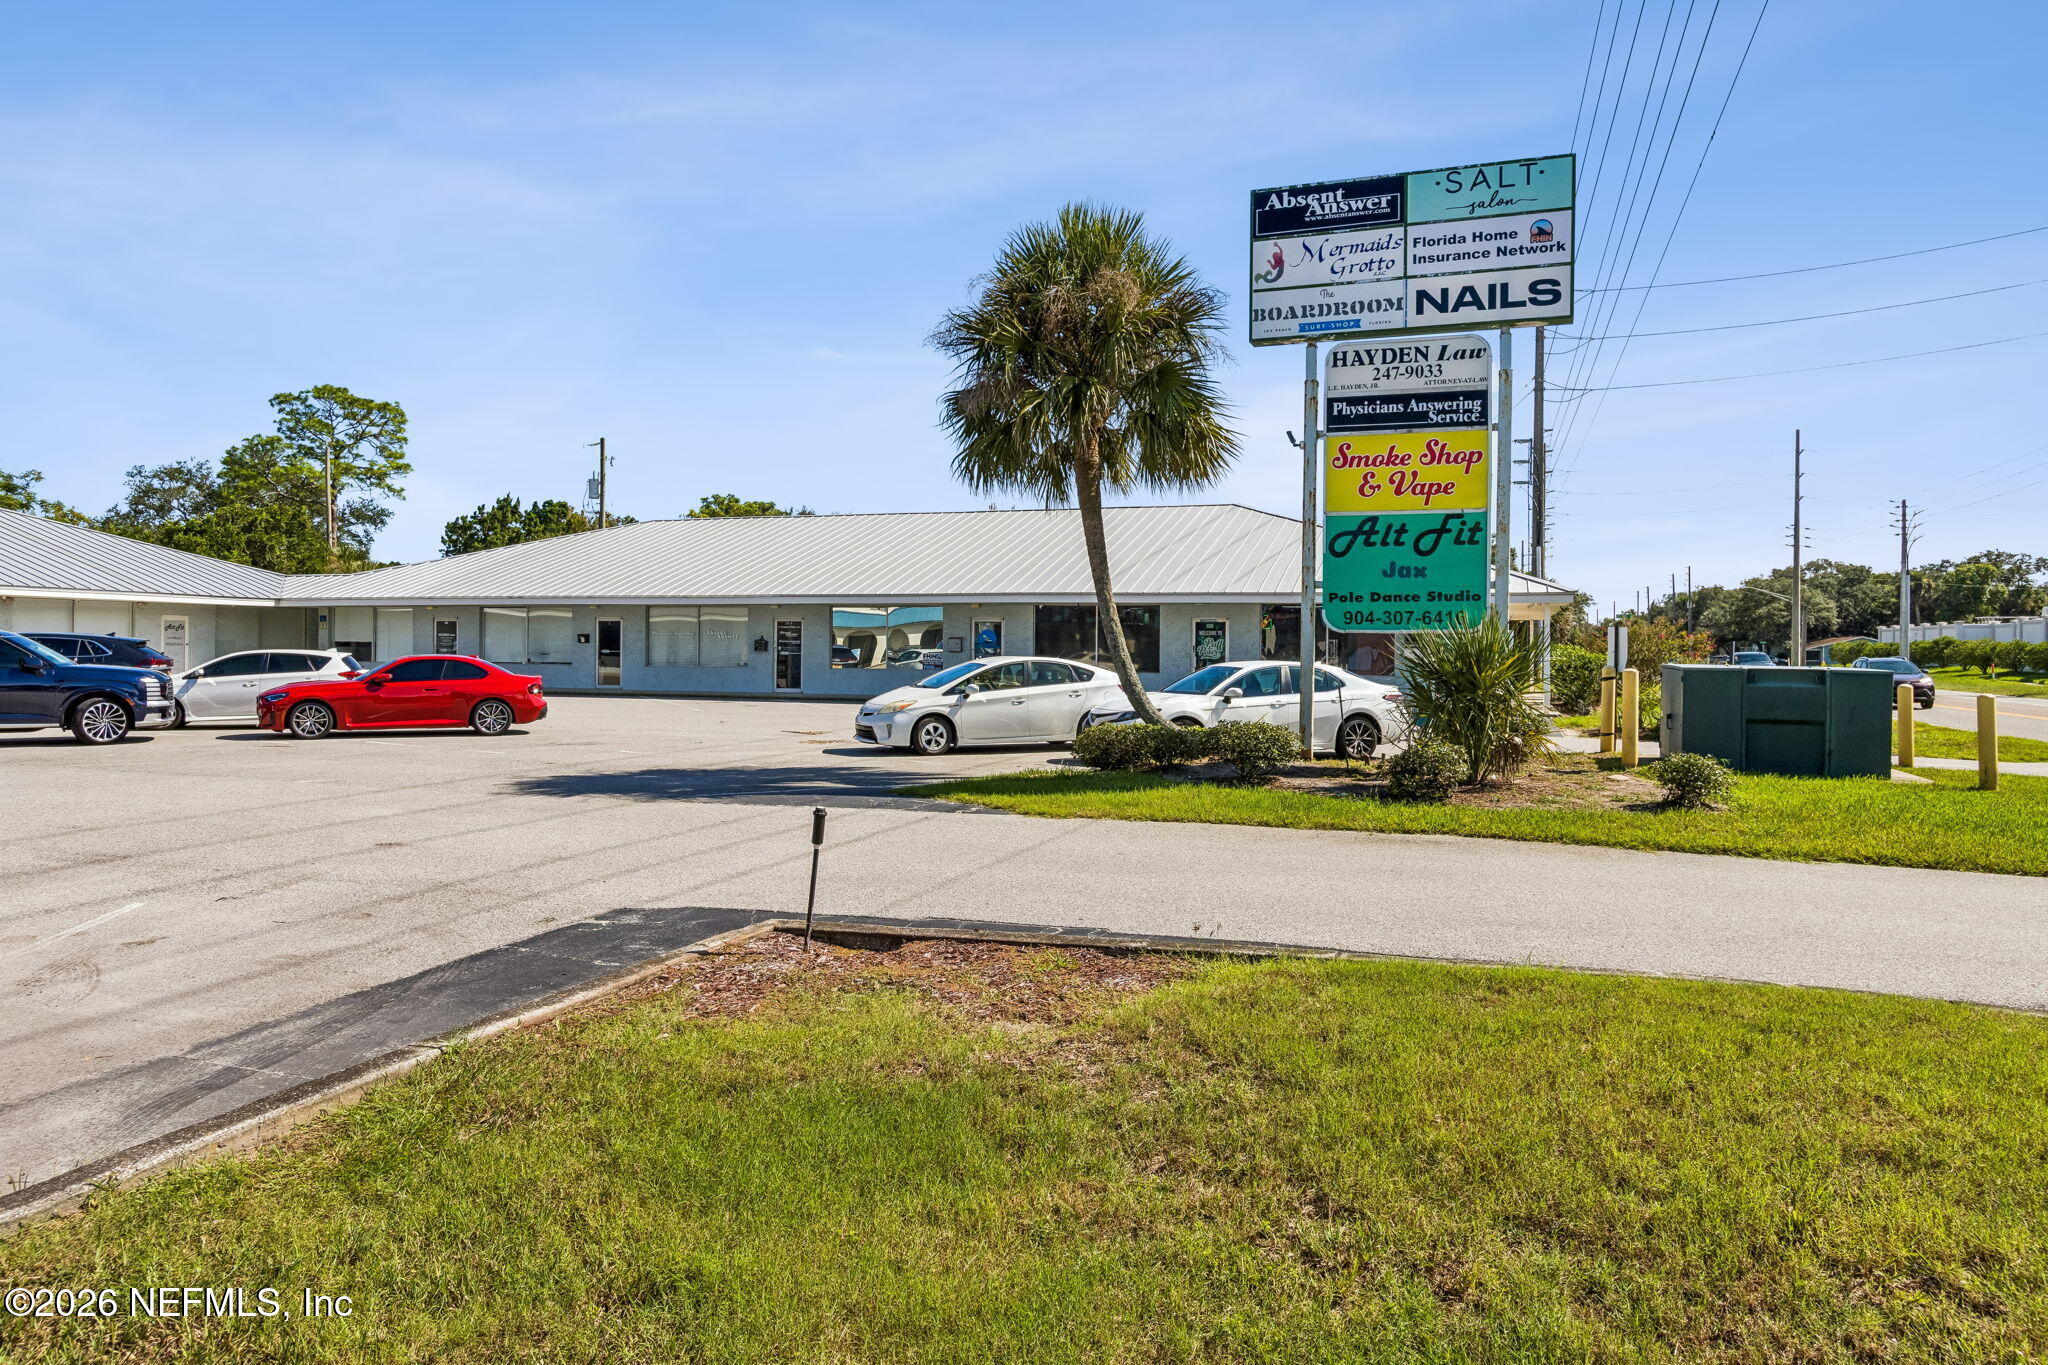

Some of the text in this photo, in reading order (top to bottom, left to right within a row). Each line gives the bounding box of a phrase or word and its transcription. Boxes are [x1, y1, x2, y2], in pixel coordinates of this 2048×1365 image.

[1445, 162, 1538, 194] SALT
[1263, 187, 1346, 211] Absent
[1305, 195, 1392, 217] Answer
[1445, 189, 1538, 215] salon
[1304, 207, 1391, 222] www.absentanswer.com
[1289, 233, 1404, 267] Mermaids
[1413, 230, 1518, 248] Florida Home
[1530, 235, 1553, 243] FHIN
[1412, 241, 1566, 265] Insurance Network
[1330, 256, 1396, 279] Grotto
[1319, 288, 1336, 299] The
[1416, 278, 1562, 316] NAILS
[1252, 297, 1403, 322] BOARDROOM
[1332, 344, 1488, 367] HAYDEN Law
[1372, 363, 1443, 381] 247-9033
[1423, 377, 1488, 386] ATTORNEY-AT-LAW
[1332, 396, 1482, 418] Physicians Answering
[1427, 409, 1481, 424] Service
[1331, 438, 1483, 475] Smoke Shop
[1358, 469, 1456, 506] & Vape
[1328, 513, 1483, 558] Alt Fit
[1382, 561, 1428, 579] Jax
[1328, 590, 1482, 603] Pole Dance Studio
